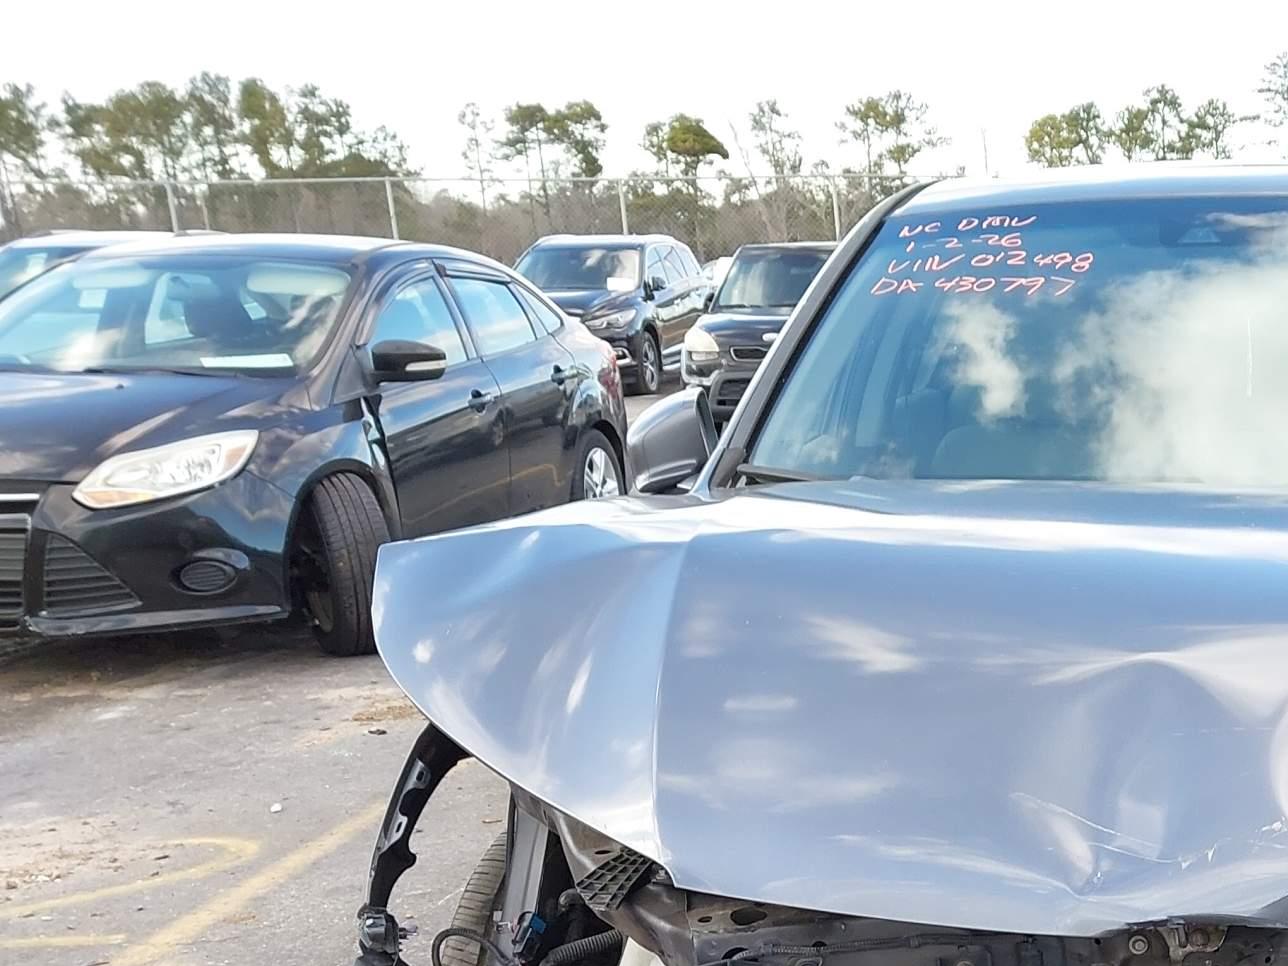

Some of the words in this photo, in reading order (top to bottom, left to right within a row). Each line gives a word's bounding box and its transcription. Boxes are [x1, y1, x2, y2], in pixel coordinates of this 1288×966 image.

[899, 222, 941, 237] NC
[957, 216, 1037, 231] DMV
[888, 254, 965, 274] VIN
[871, 277, 923, 295] DA
